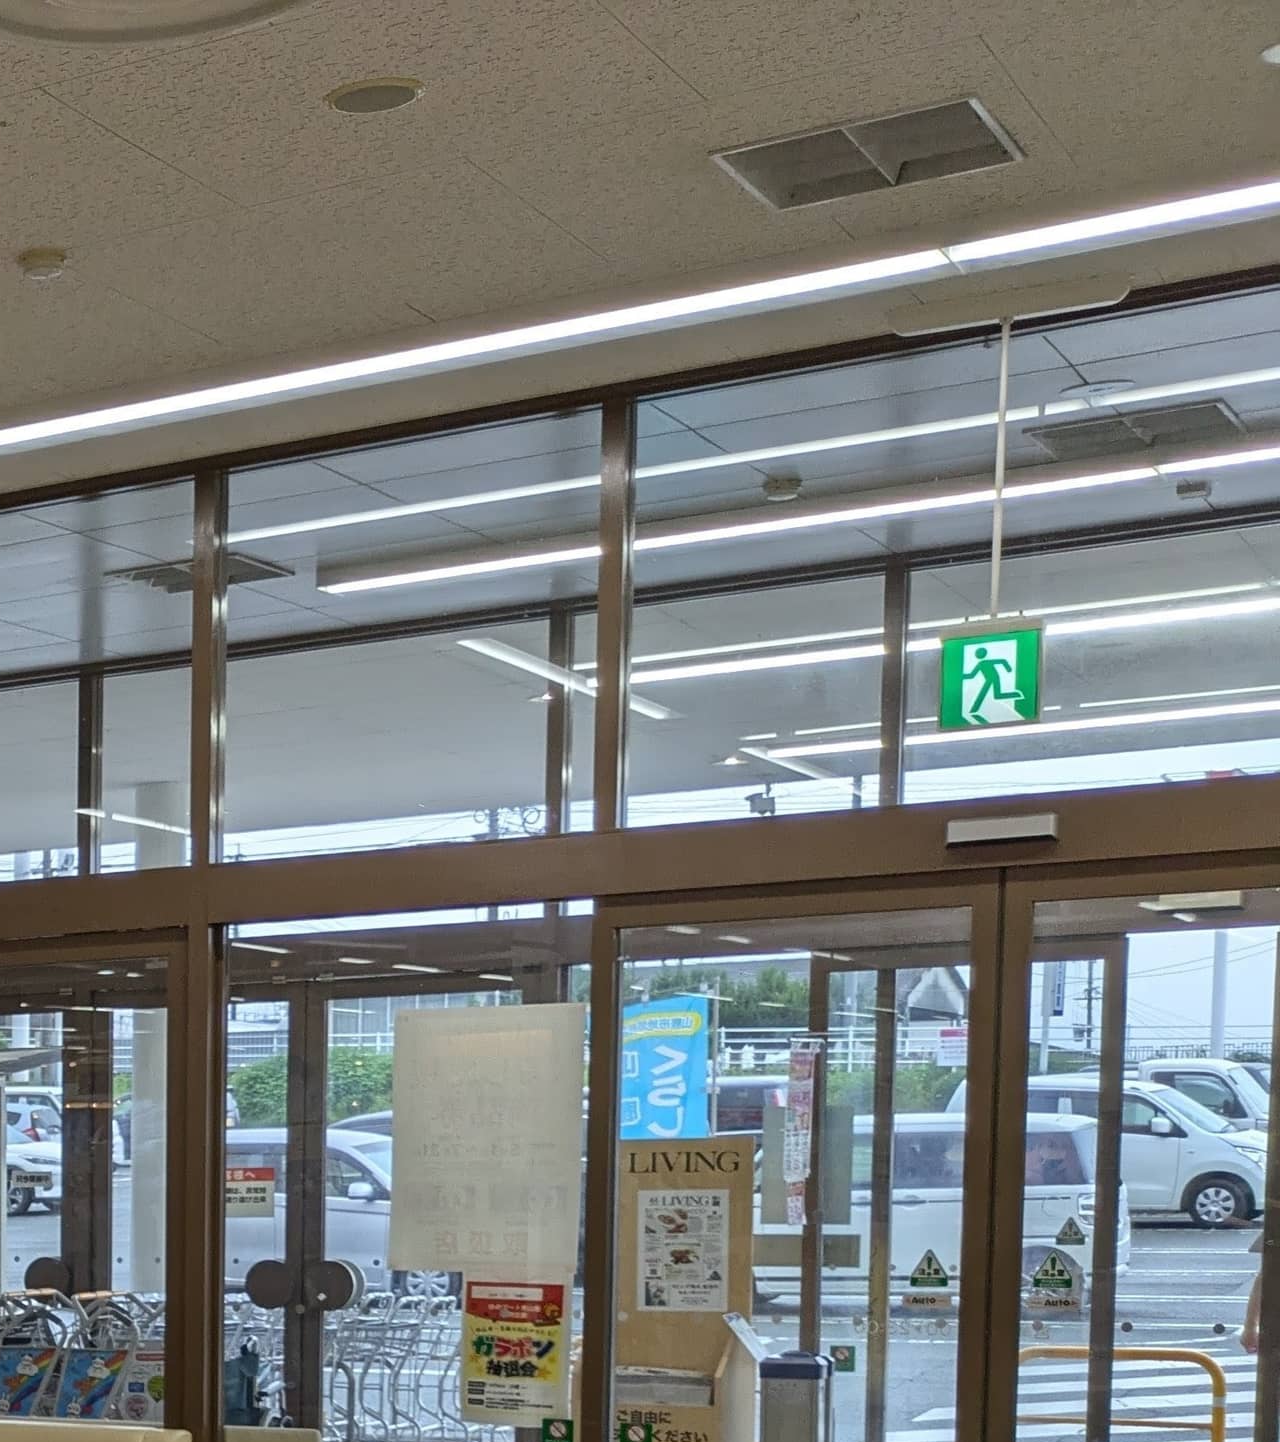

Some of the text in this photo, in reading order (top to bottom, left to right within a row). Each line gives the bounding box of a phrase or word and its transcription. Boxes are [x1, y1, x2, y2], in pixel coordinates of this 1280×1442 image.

[628, 1150, 741, 1174] LIVING
[472, 1335, 555, 1359] ガラポン
[616, 1409, 672, 1425] ご自由に
